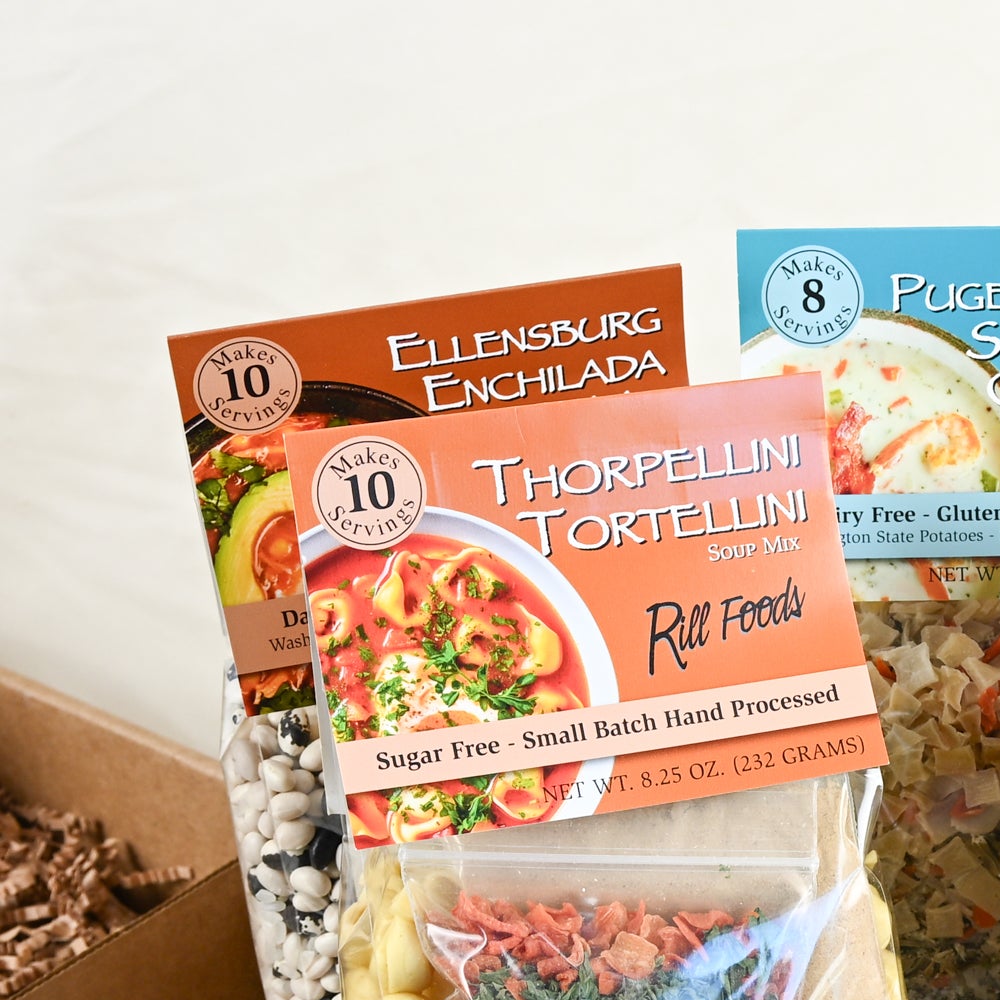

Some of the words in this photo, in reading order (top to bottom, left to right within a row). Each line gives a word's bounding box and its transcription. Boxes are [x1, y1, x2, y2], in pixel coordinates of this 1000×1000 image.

[781, 256, 844, 281] Makes
[802, 279, 826, 313] 8
[773, 305, 852, 336] Servings
[210, 344, 277, 371] Makes
[387, 307, 664, 374] ELLENSBURG
[221, 364, 270, 402] 10
[423, 350, 668, 413] ENCHILADA
[208, 388, 291, 423] Servings
[328, 447, 400, 481] Makes
[471, 433, 802, 507] THORPELLINI
[344, 471, 396, 513] 10
[327, 498, 415, 537] Servings
[516, 488, 808, 557] TORTELLINI
[836, 507, 864, 527] iry
[872, 507, 916, 523] Free
[877, 529, 914, 544] State
[920, 529, 984, 543] Potatoes
[929, 566, 969, 583] NET
[646, 600, 711, 676] Rill
[720, 576, 806, 641] Foods
[376, 745, 444, 772] Sugar
[451, 738, 501, 761] Free
[522, 722, 587, 751] Small
[594, 714, 658, 740] Batch
[664, 703, 725, 728] Hand
[731, 683, 840, 719] Processed
[543, 780, 585, 804] NET
[595, 774, 634, 796] WT.
[641, 767, 682, 790] 8.25
[689, 761, 725, 783] OZ.
[732, 751, 776, 777] (232
[782, 734, 867, 765] GRAMS)
